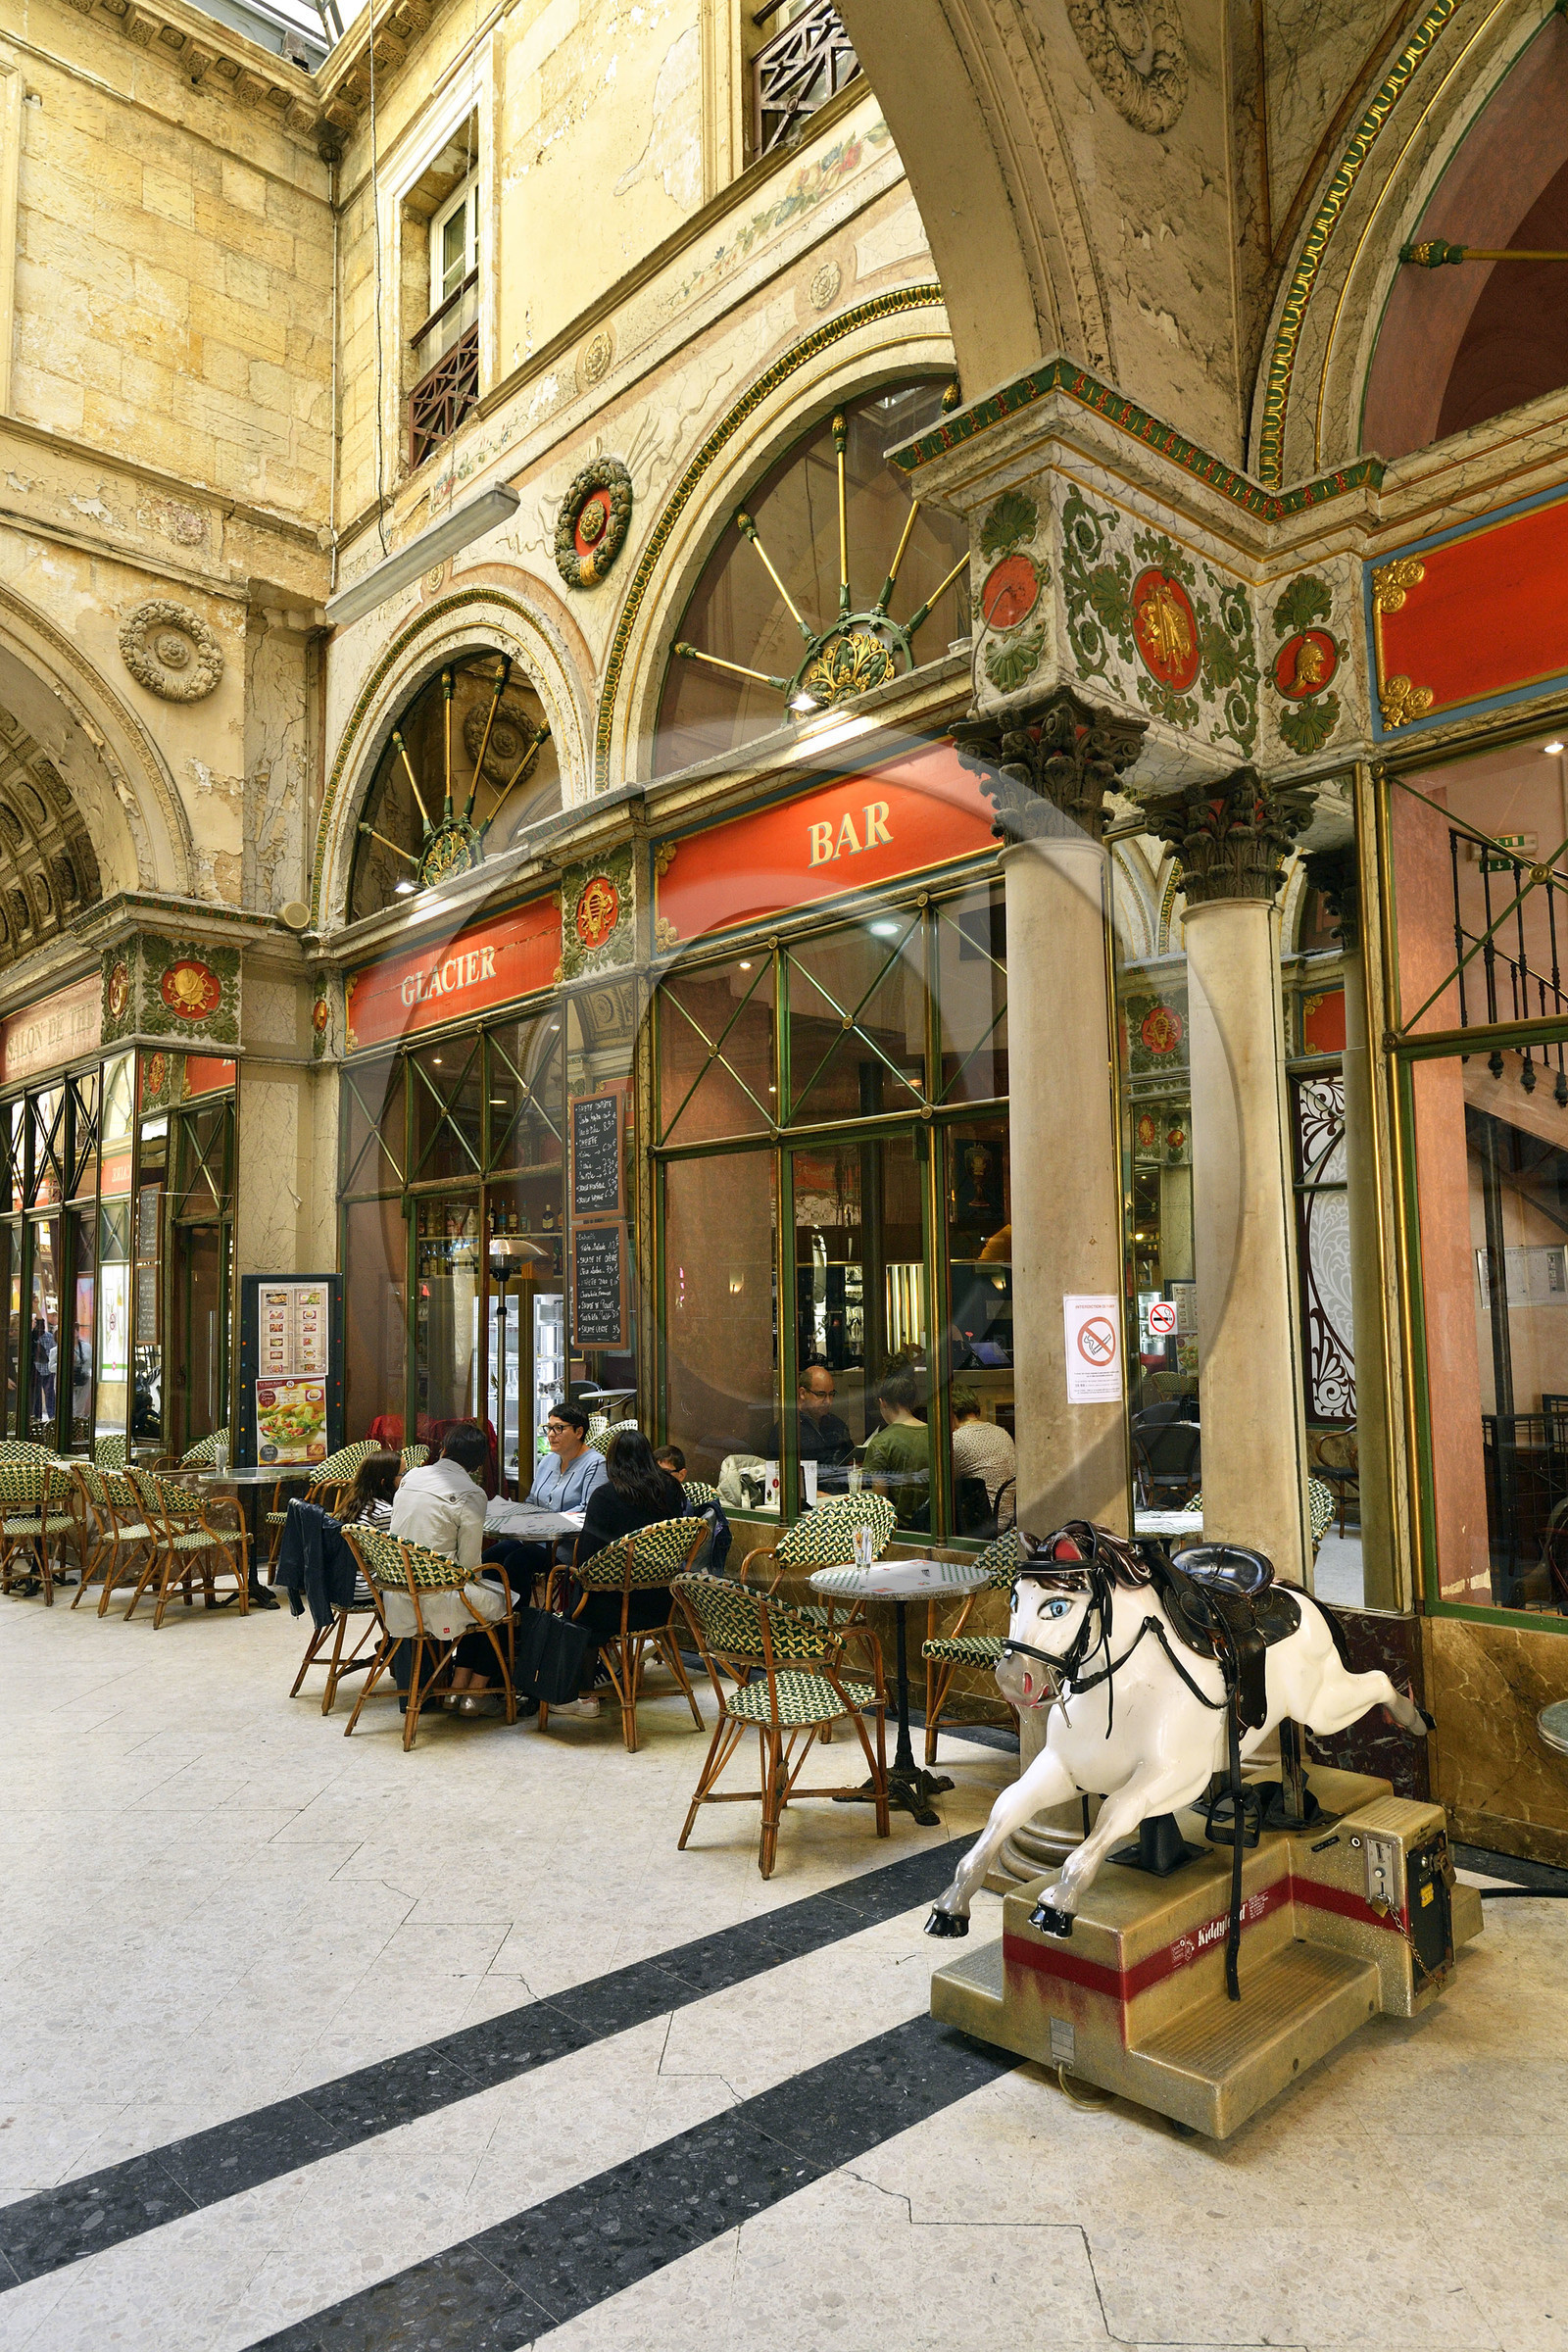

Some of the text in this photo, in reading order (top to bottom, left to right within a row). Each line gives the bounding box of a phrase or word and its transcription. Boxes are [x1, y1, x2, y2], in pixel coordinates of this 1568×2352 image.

[808, 801, 894, 868] BAR
[401, 945, 497, 1007] GLACIER
[7, 1021, 43, 1062] SALON
[1198, 1903, 1246, 1947] Kiddyld
